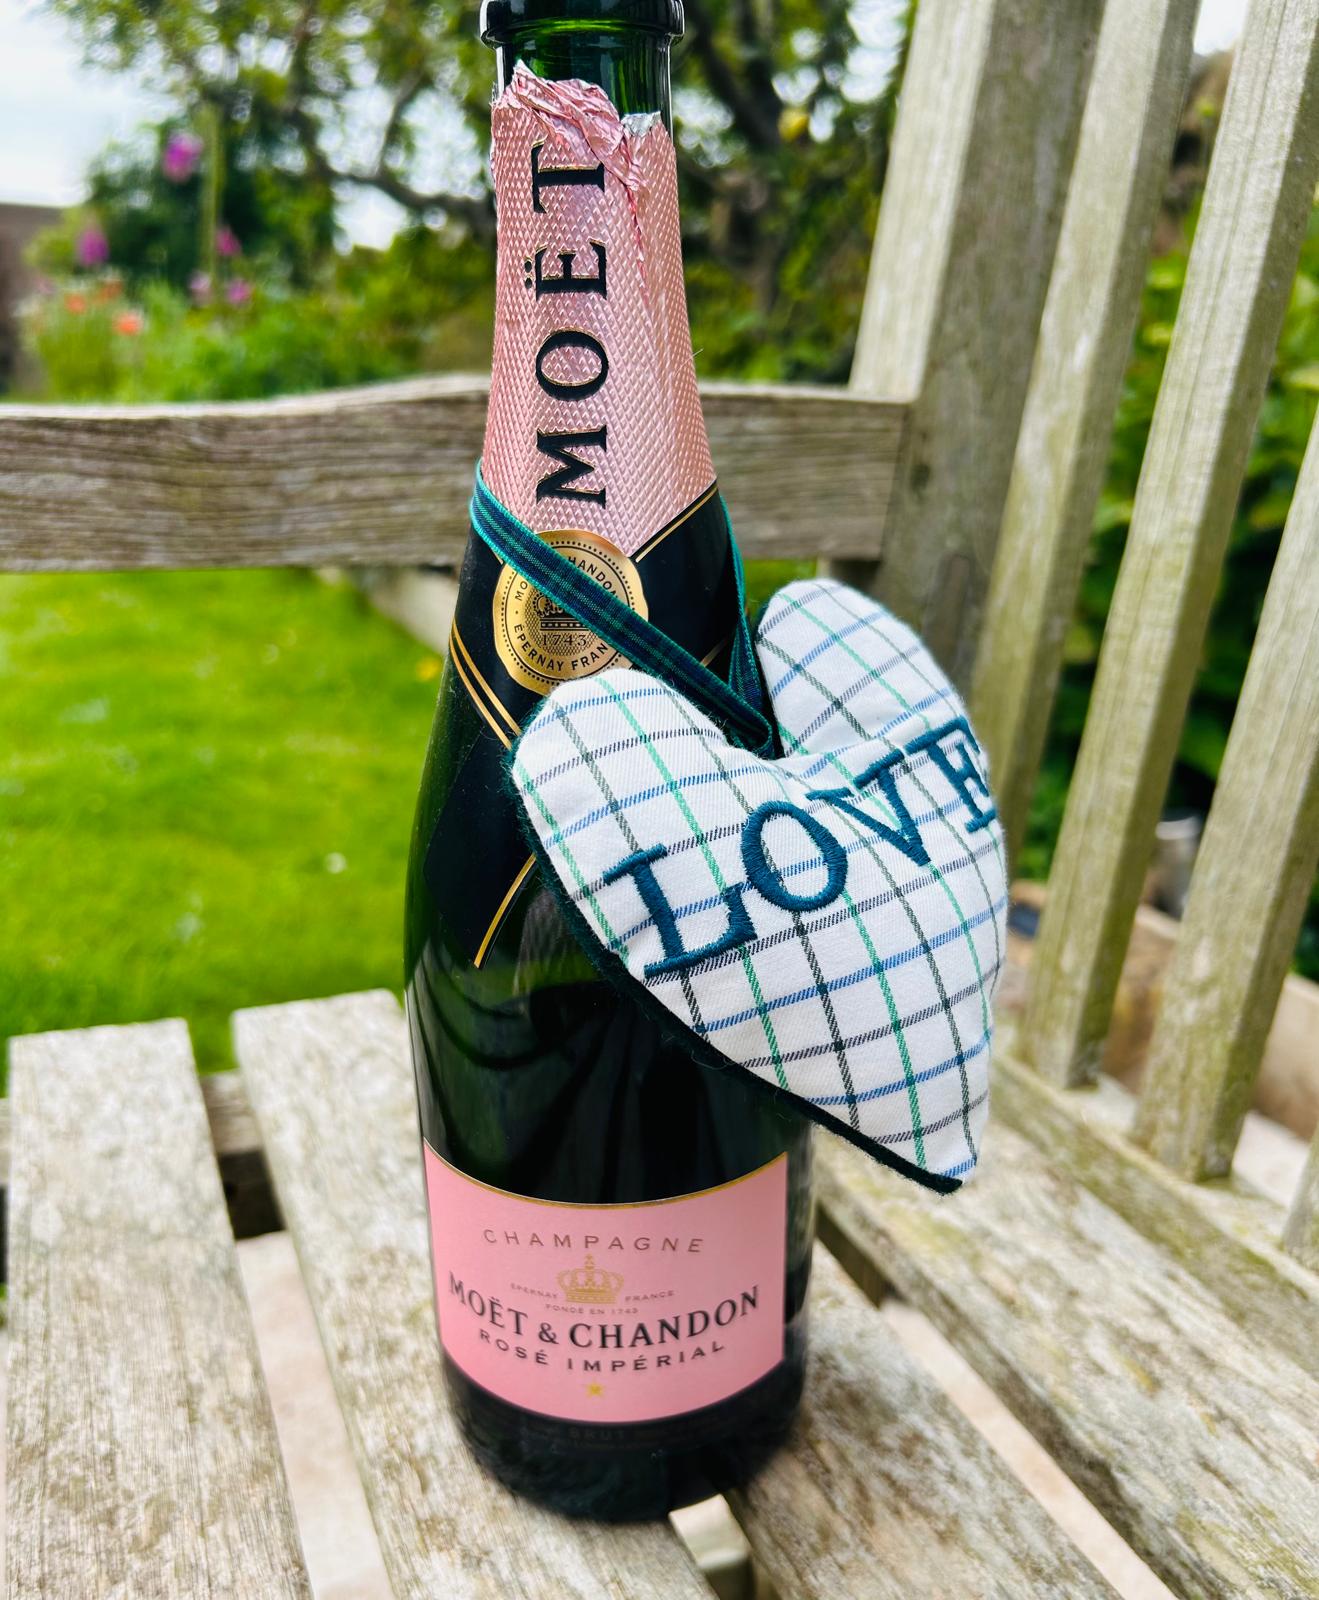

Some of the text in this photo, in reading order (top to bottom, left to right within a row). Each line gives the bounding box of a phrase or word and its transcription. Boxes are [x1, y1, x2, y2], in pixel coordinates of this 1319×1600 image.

[524, 136, 609, 509] MOËT
[568, 556, 618, 598] HANDO
[514, 623, 609, 672] ÉPERNAY FRAN
[542, 634, 588, 646] 1743
[603, 715, 997, 981] LOVE
[483, 1228, 704, 1253] CHAMPAGNE
[449, 1271, 759, 1349] MOËT & CHANDON
[612, 1307, 639, 1315] 1743
[624, 1290, 675, 1302] FRANCE
[480, 1328, 724, 1372] ROSÉ IMPÉRIAL
